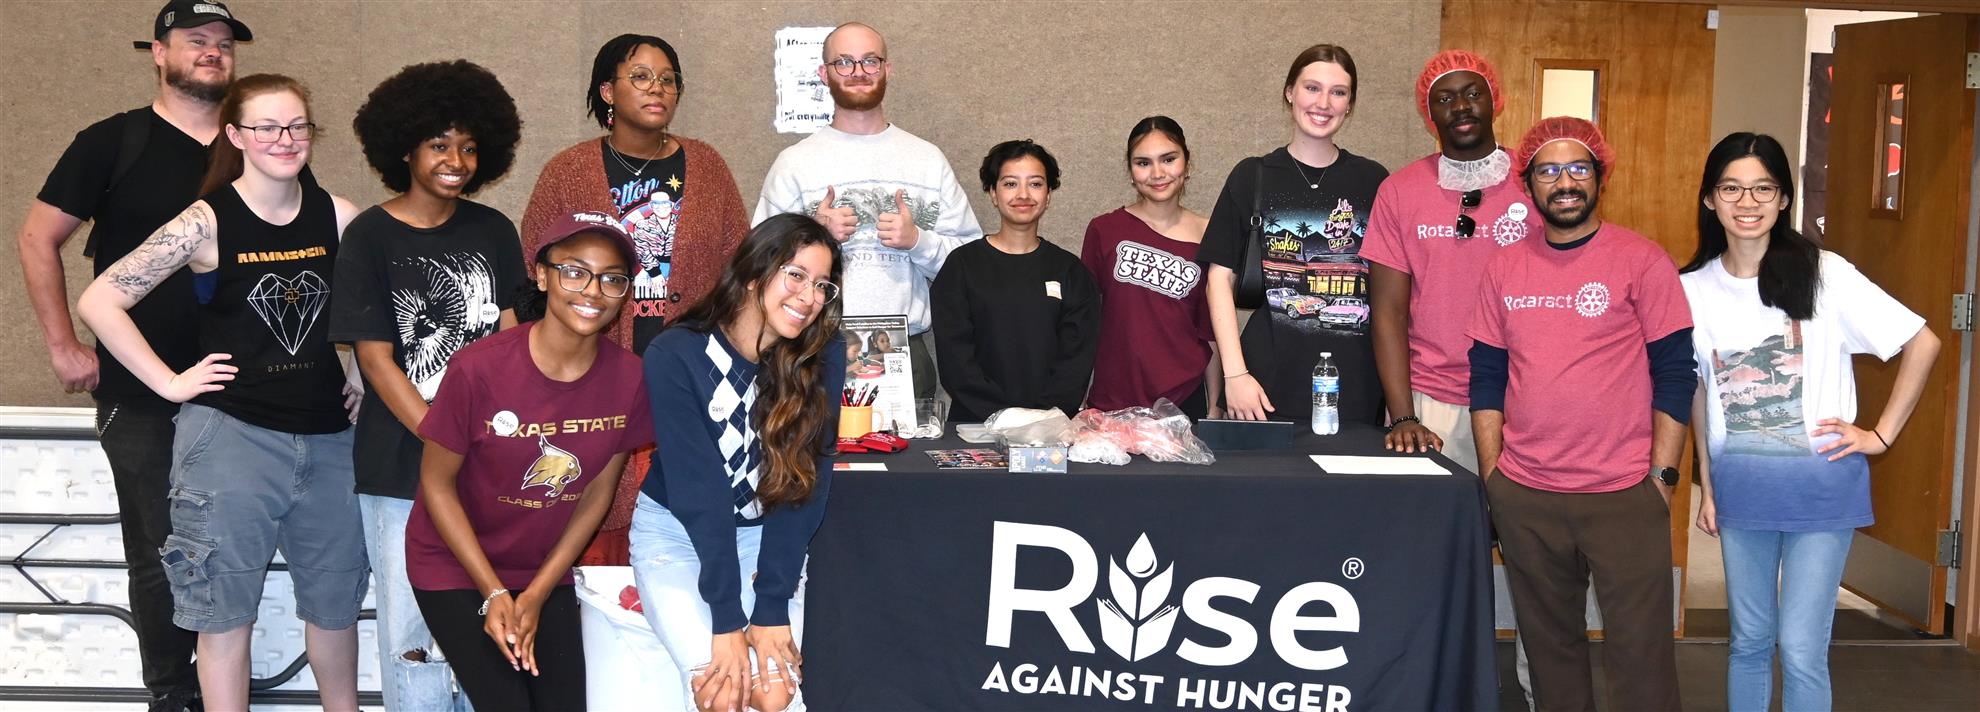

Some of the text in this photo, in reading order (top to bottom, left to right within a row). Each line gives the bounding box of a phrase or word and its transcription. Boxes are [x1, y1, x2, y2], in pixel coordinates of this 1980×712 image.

[1269, 231, 1299, 253] Shakes
[1121, 245, 1198, 283] TEXAS
[1118, 261, 1189, 296] STATE
[1503, 294, 1573, 311] Rotaract
[267, 361, 315, 373] DIAMANT
[484, 415, 627, 438] TXAS STATE
[497, 495, 543, 509] CLASS
[981, 660, 1353, 712] AGAINST HUNGER
